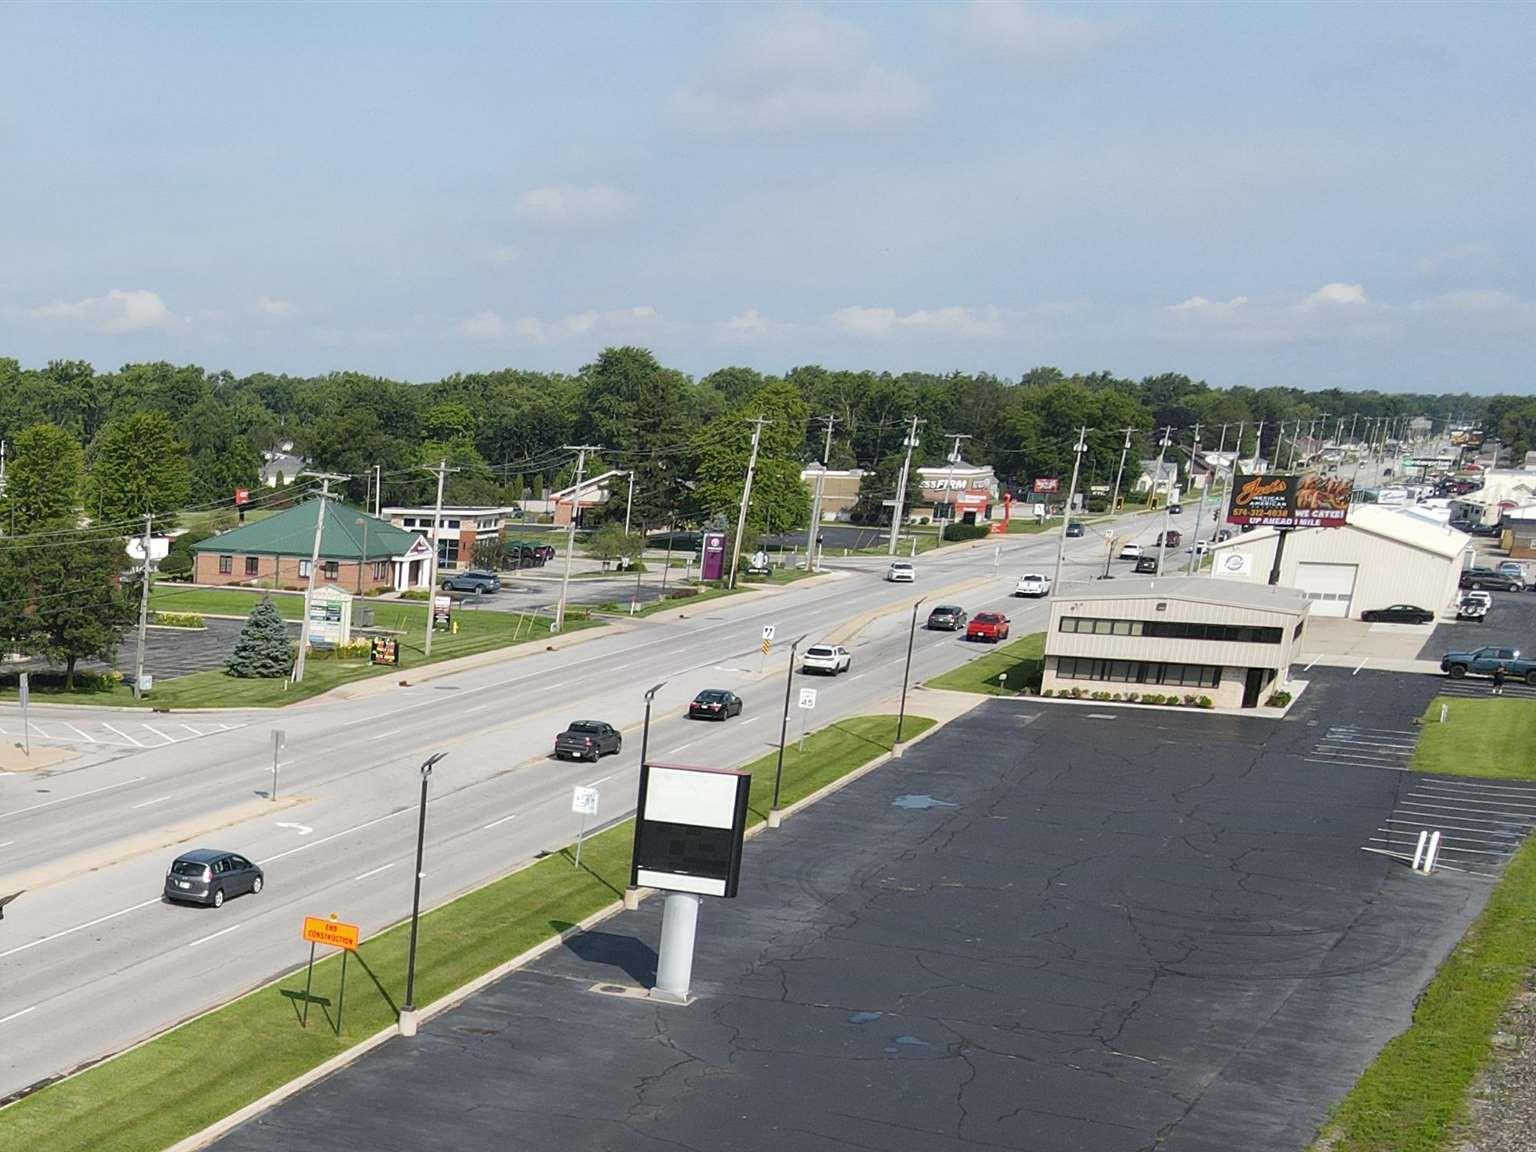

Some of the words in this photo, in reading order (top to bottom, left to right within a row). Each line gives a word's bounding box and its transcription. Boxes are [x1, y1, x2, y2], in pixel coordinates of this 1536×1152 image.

[1295, 509, 1310, 517] WE
[1299, 518, 1322, 526] MILE
[325, 924, 337, 932] END
[308, 930, 353, 945] CONSTRUCTION
